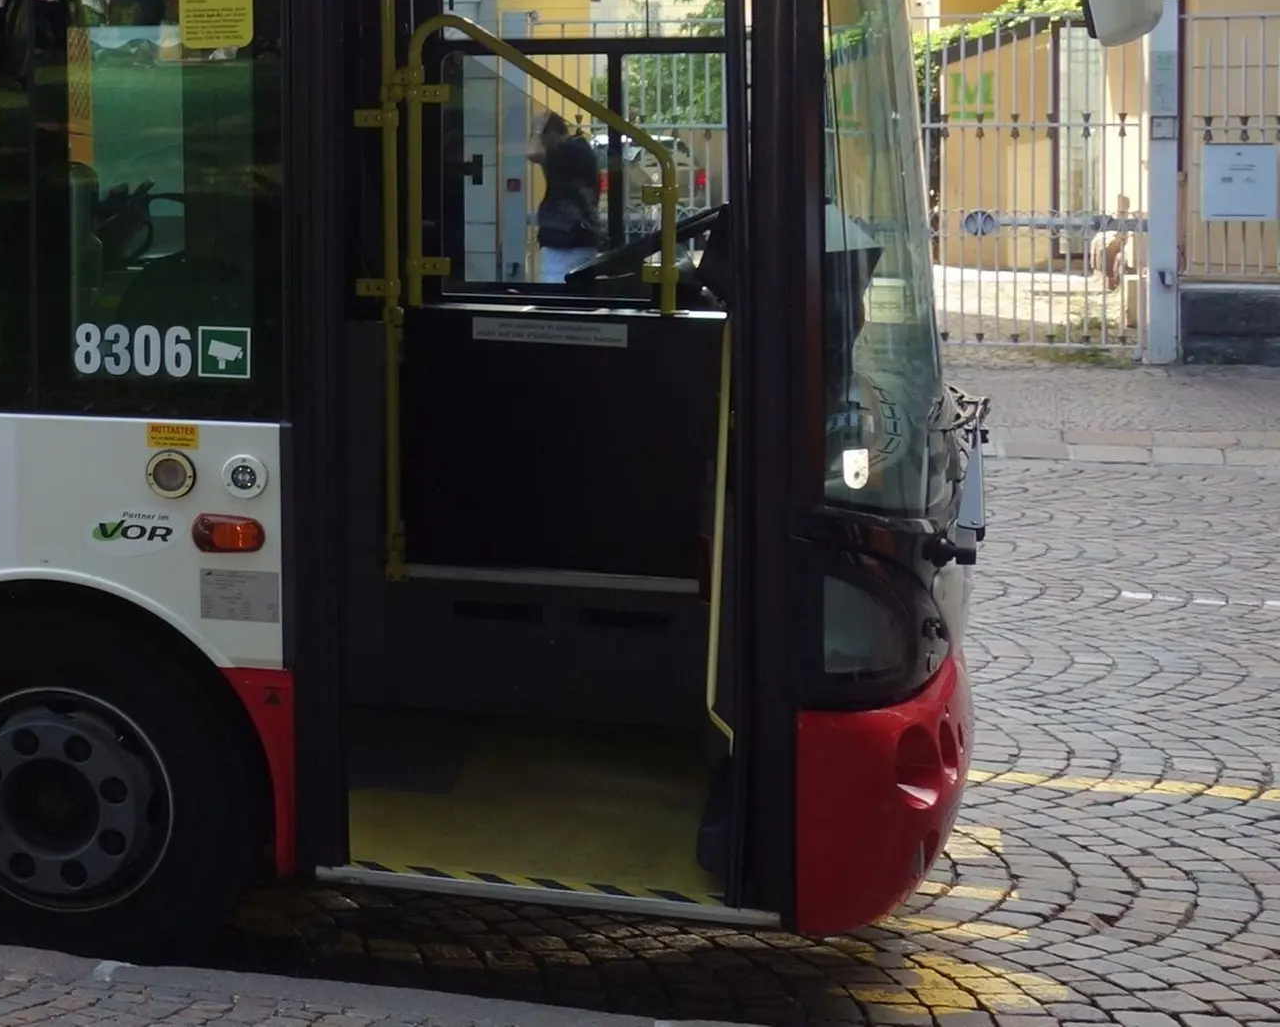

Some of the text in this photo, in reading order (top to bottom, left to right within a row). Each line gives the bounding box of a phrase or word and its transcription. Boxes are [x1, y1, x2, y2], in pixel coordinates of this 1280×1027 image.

[74, 322, 192, 378] 8306
[122, 511, 170, 521] Partner im
[98, 520, 174, 542] VOR
